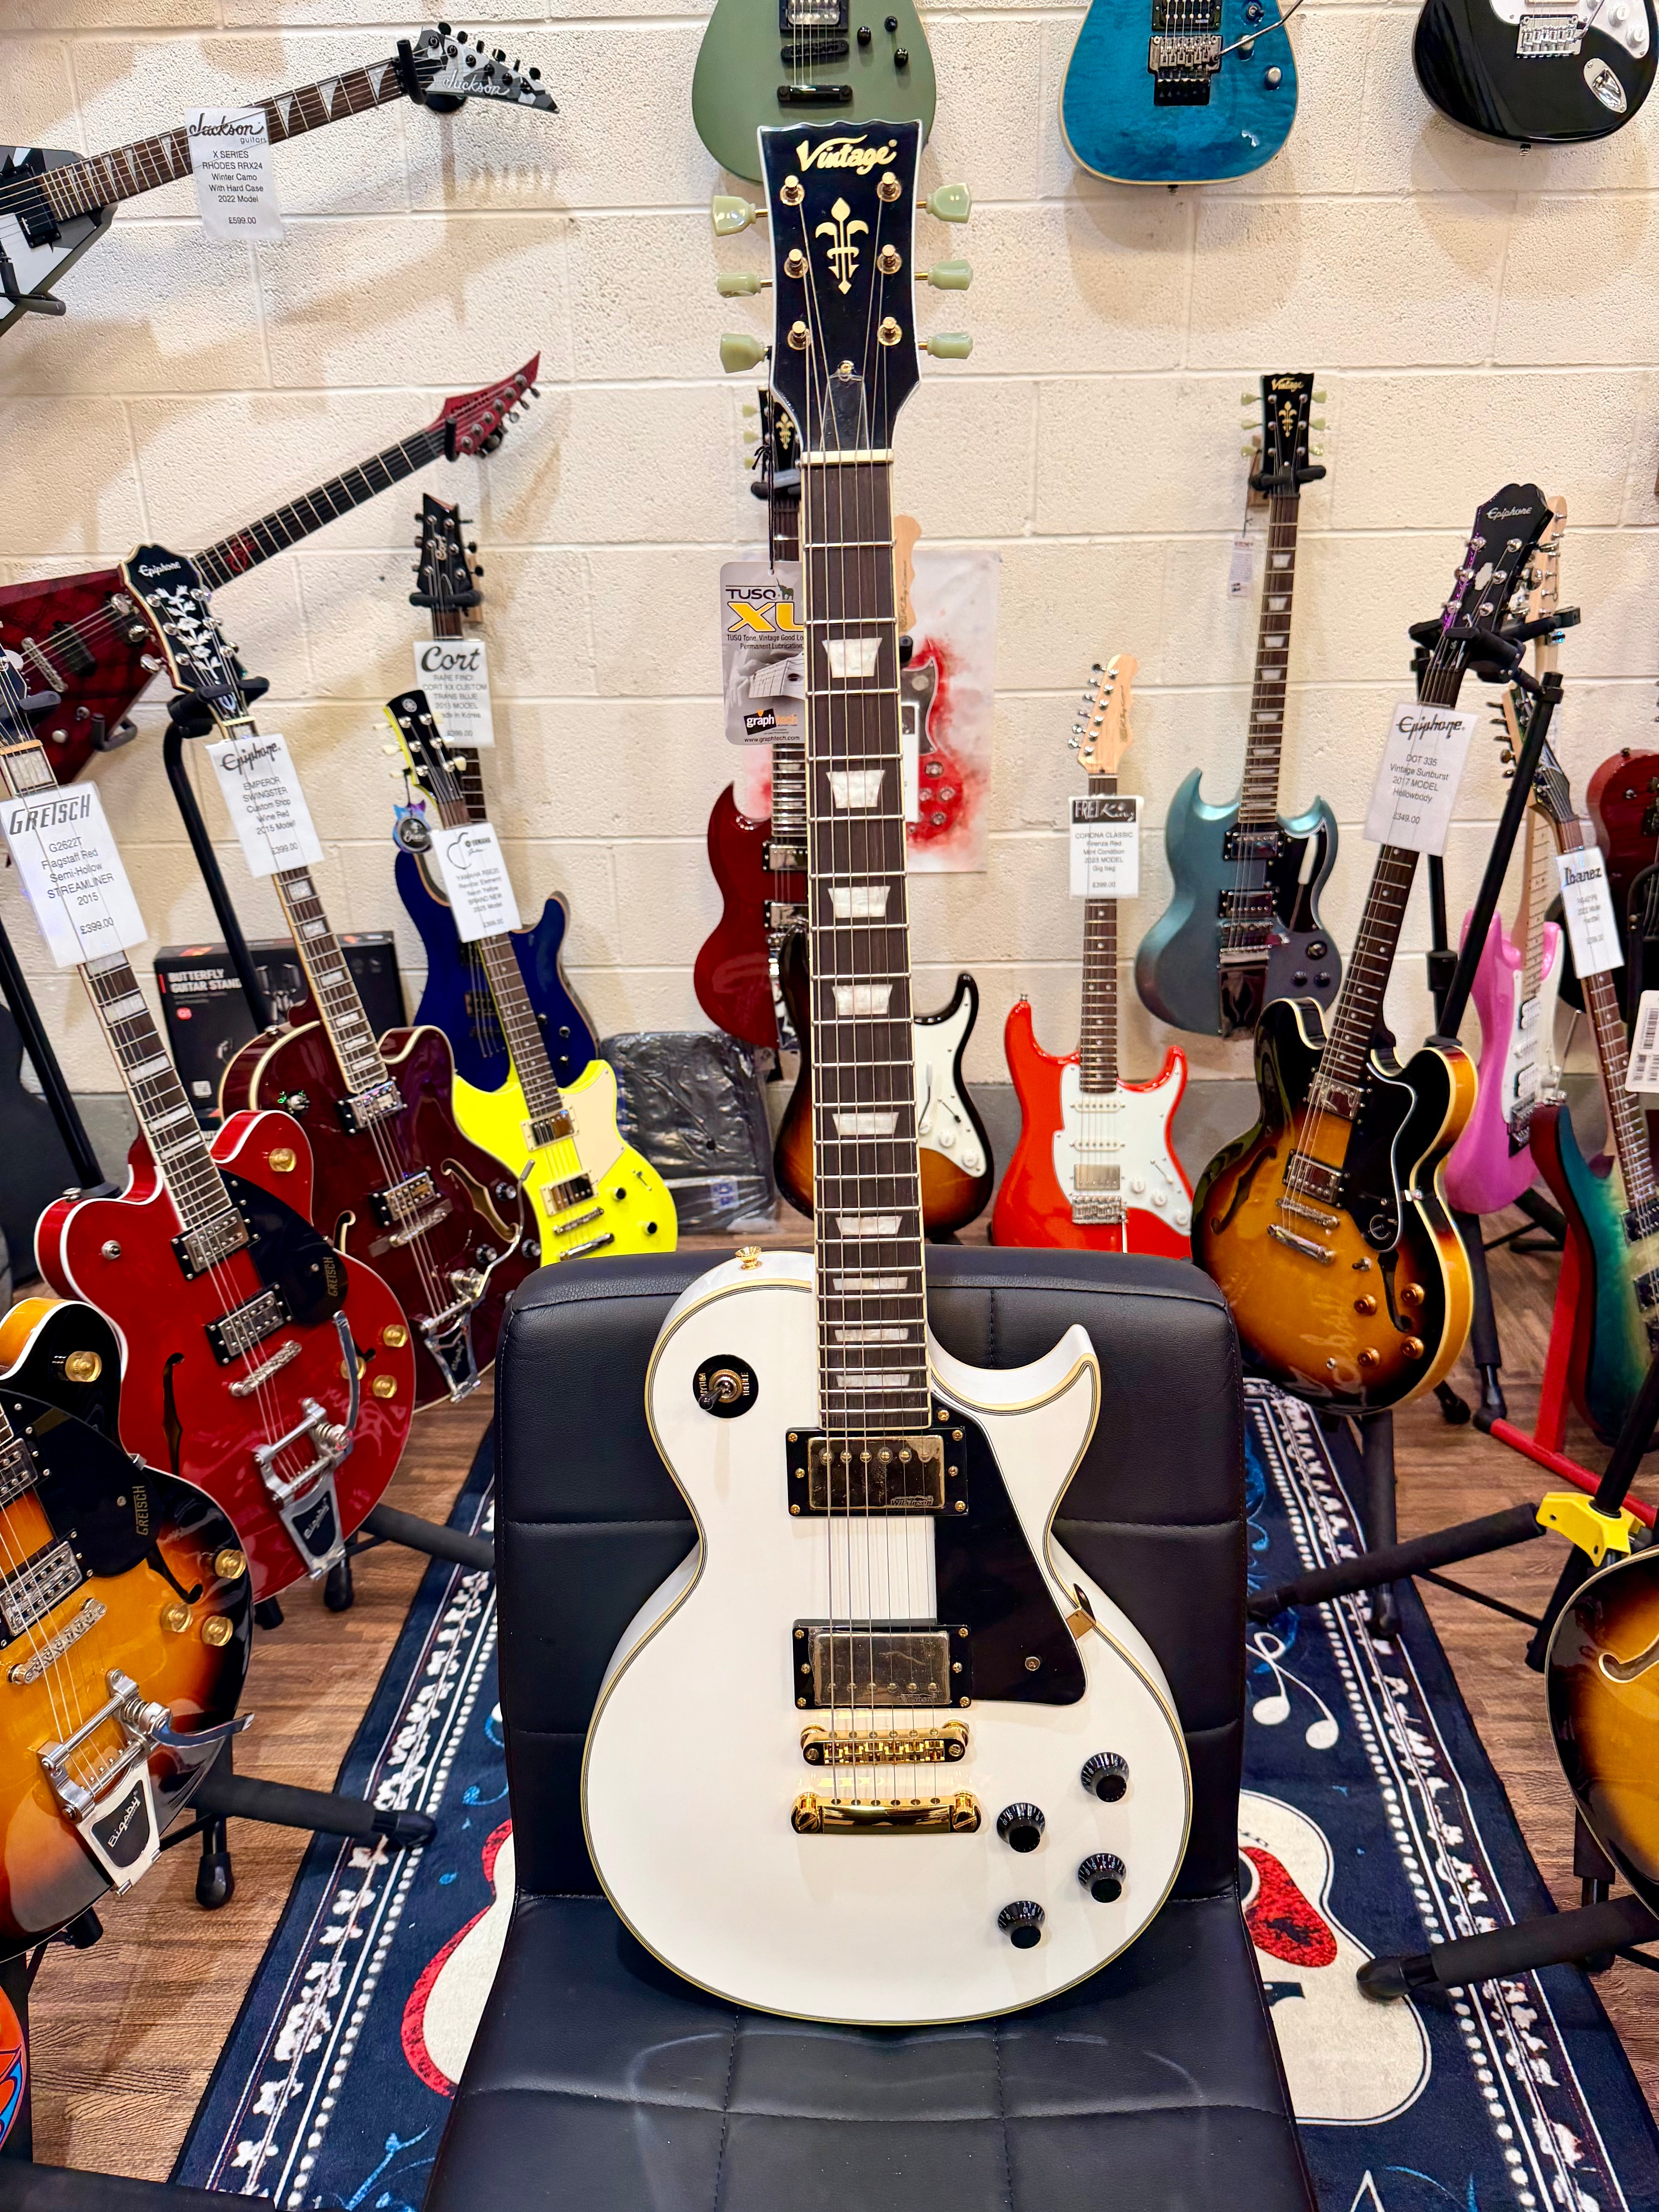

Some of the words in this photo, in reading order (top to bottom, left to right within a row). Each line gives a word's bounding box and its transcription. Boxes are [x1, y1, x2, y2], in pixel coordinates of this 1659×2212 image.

[189, 113, 264, 136] Jackson
[796, 134, 898, 175] Vintage
[1486, 507, 1532, 520] Epiphone
[138, 561, 181, 578] Epiphone
[726, 589, 777, 600] TUSQ
[727, 601, 804, 632] XL
[421, 646, 480, 672] Cort
[747, 714, 775, 728] graph
[1396, 714, 1462, 740] Epiphone
[220, 742, 278, 775] Epiphone
[1406, 754, 1422, 763] DOT
[1423, 757, 1437, 766] 335
[1390, 763, 1415, 776] Vintage
[1416, 768, 1448, 781] Sunburst
[243, 776, 282, 790] EMPEROR
[1411, 779, 1438, 791] MODEL
[243, 787, 289, 802] SWINGSTER
[1393, 788, 1433, 804] Hollowbody
[9, 794, 91, 835] GRETSCH
[246, 802, 275, 813] Custom
[1075, 800, 1101, 819] FRET
[1392, 812, 1420, 824] £349.00
[49, 836, 82, 853] G2622T
[82, 848, 98, 860] Red
[50, 862, 103, 883] Semi-Hollow
[1564, 867, 1602, 886] Ibanez
[47, 873, 114, 899] STREAMLINER
[77, 893, 99, 905] 2015
[80, 917, 113, 935] £399.00
[167, 969, 224, 982] BUTTERFLY
[170, 981, 208, 993] GUITAR
[208, 978, 242, 990] STAND
[323, 1257, 338, 1297] GRETSCH
[132, 1486, 149, 1535] GRETSCH
[891, 1499, 932, 1507] Wilkinson
[108, 1796, 141, 1848] Bigsby
